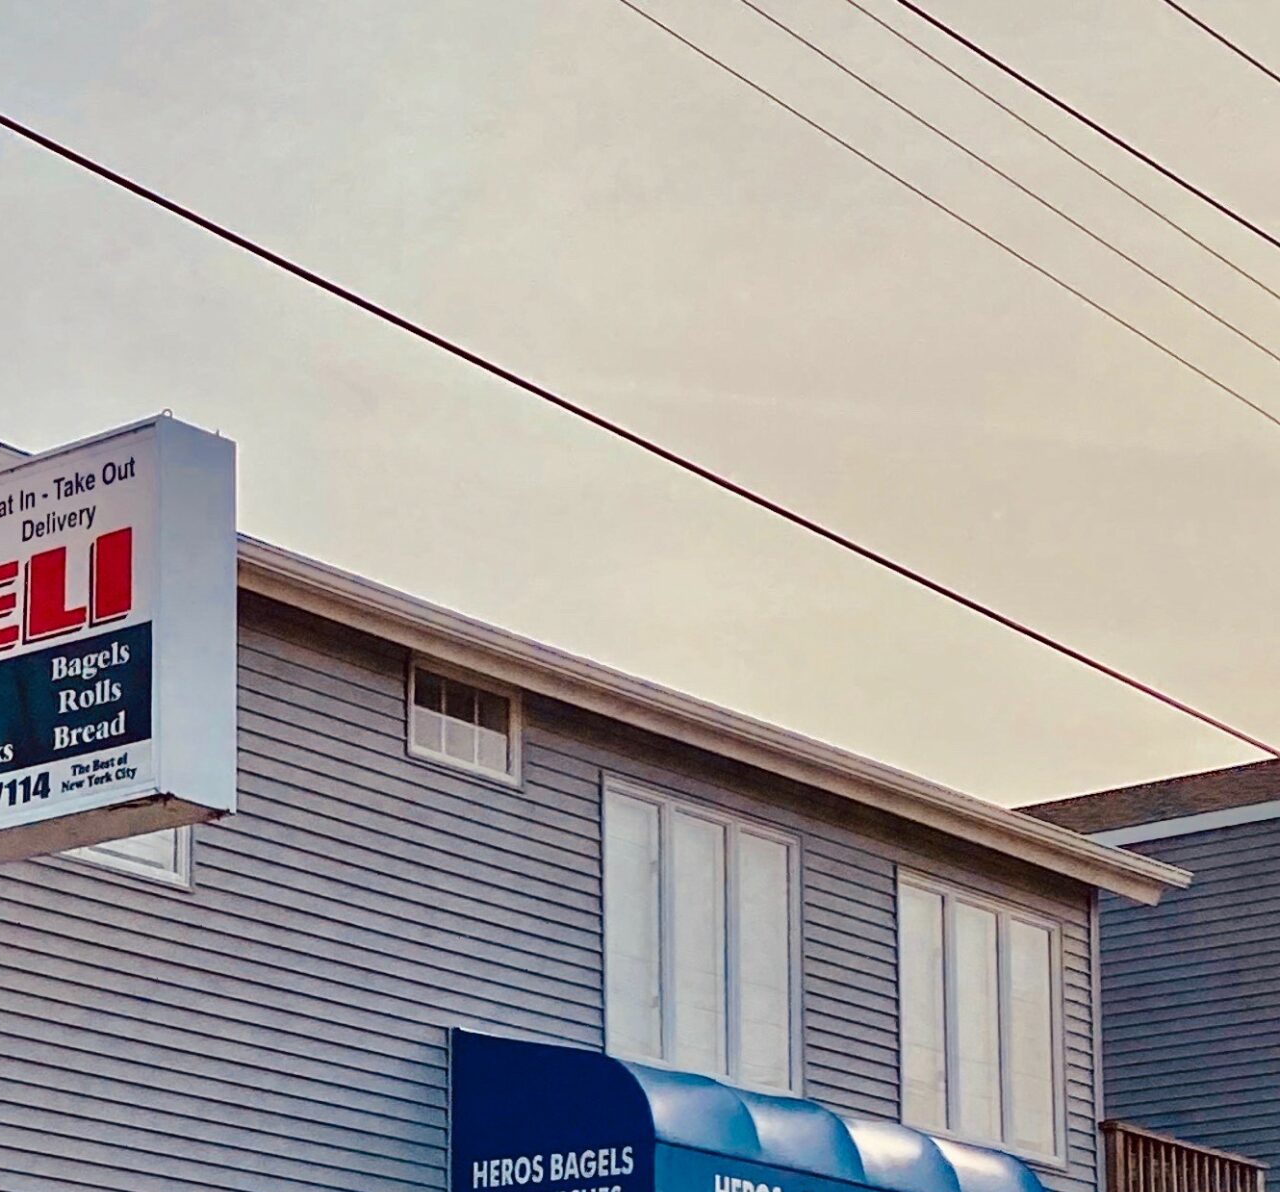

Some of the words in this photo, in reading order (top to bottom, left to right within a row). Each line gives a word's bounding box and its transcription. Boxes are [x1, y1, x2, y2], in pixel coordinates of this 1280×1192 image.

[20, 490, 36, 510] In
[53, 473, 96, 501] Take
[102, 456, 135, 485] Out
[21, 506, 96, 542] Delivery
[51, 641, 131, 682] Bagels
[58, 683, 122, 715] Rolls
[53, 712, 126, 751] Bread
[61, 780, 85, 793] New
[87, 772, 113, 787] York
[115, 767, 137, 780] City
[71, 764, 90, 776] The
[93, 757, 115, 772] Best
[117, 752, 128, 766] of
[473, 1154, 544, 1189] HEROS
[550, 1145, 634, 1180] BAGELS
